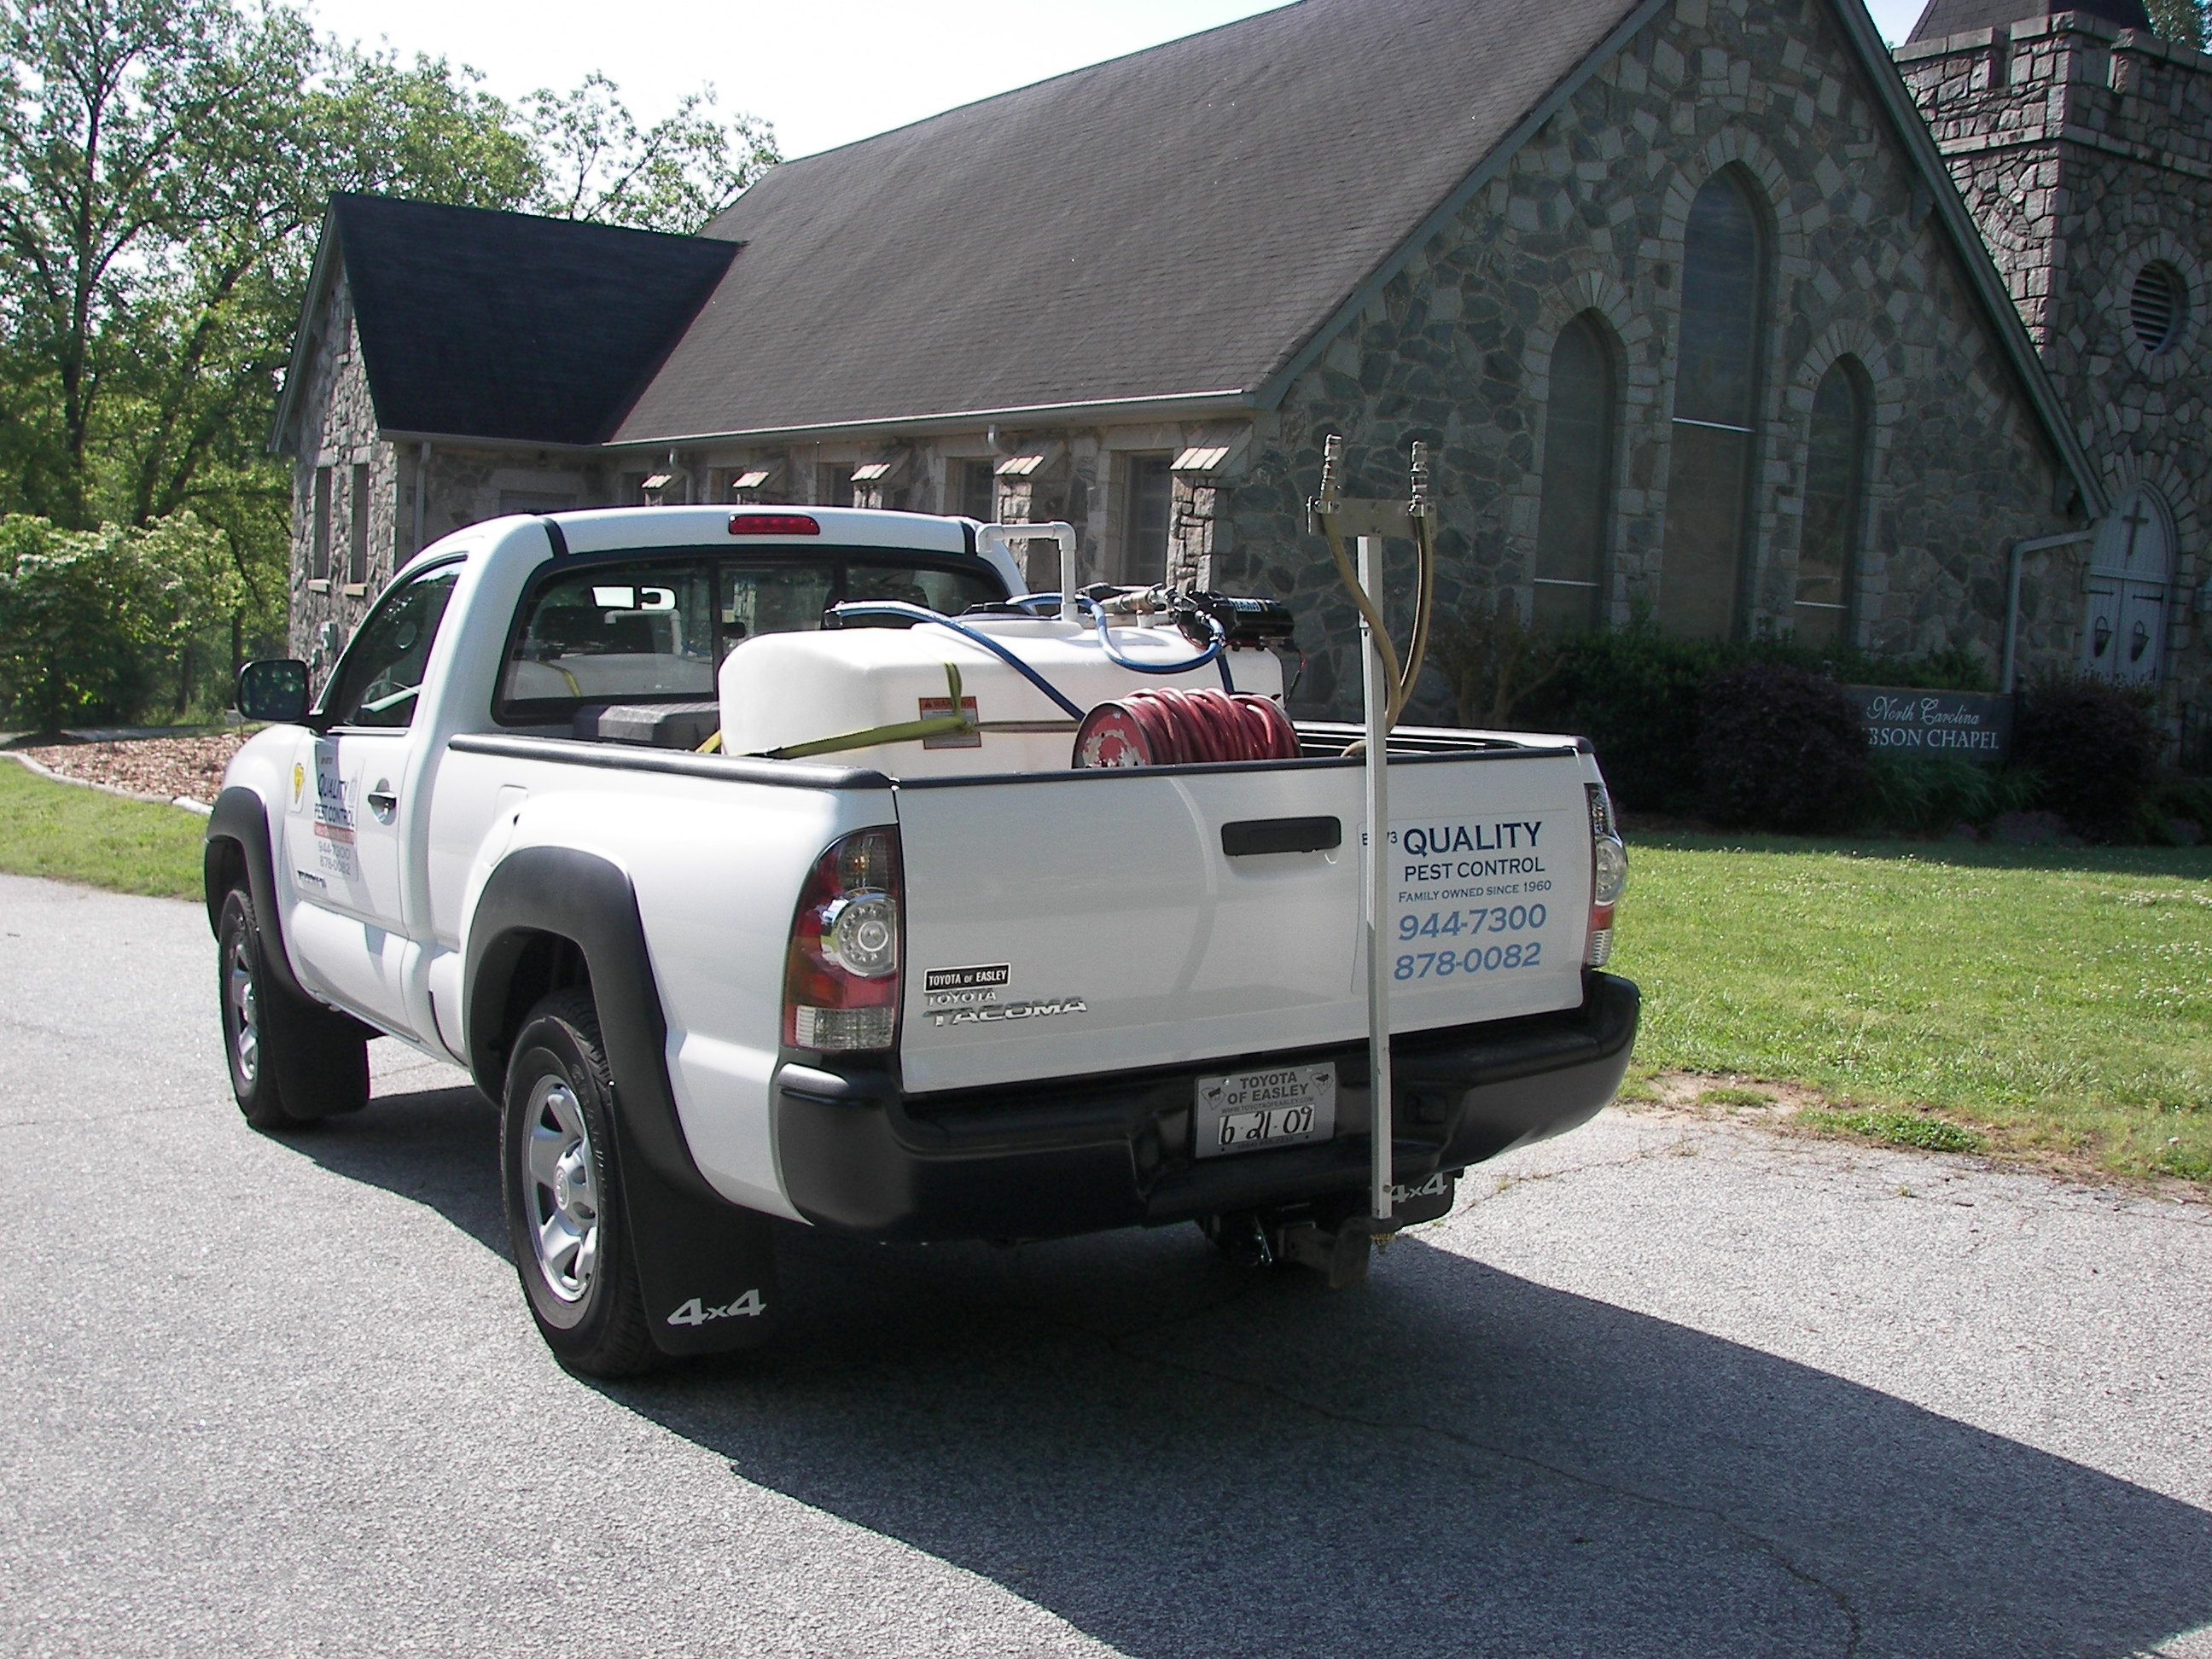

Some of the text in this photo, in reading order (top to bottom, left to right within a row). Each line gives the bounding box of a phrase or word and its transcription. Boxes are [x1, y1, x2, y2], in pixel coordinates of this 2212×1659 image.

[1866, 696, 1980, 725] North Carolina
[1927, 730, 1999, 749] CHAPEL
[1404, 821, 1542, 858] QUALITY
[1405, 857, 1545, 882] PEST CONTROL
[1399, 880, 1551, 902] FAMILY OWNED SINCE 1960
[1398, 903, 1546, 940] 944-7300
[1394, 942, 1541, 981] 878-0082
[928, 974, 961, 987] TOYOTA
[975, 969, 1007, 983] EASLEY
[928, 987, 998, 1007] TOYOTA
[923, 996, 1087, 1027] TACOMA
[1240, 1071, 1297, 1090] TOYOTA
[1227, 1083, 1308, 1105] OF EASLEY
[667, 1289, 767, 1326] 4x4
